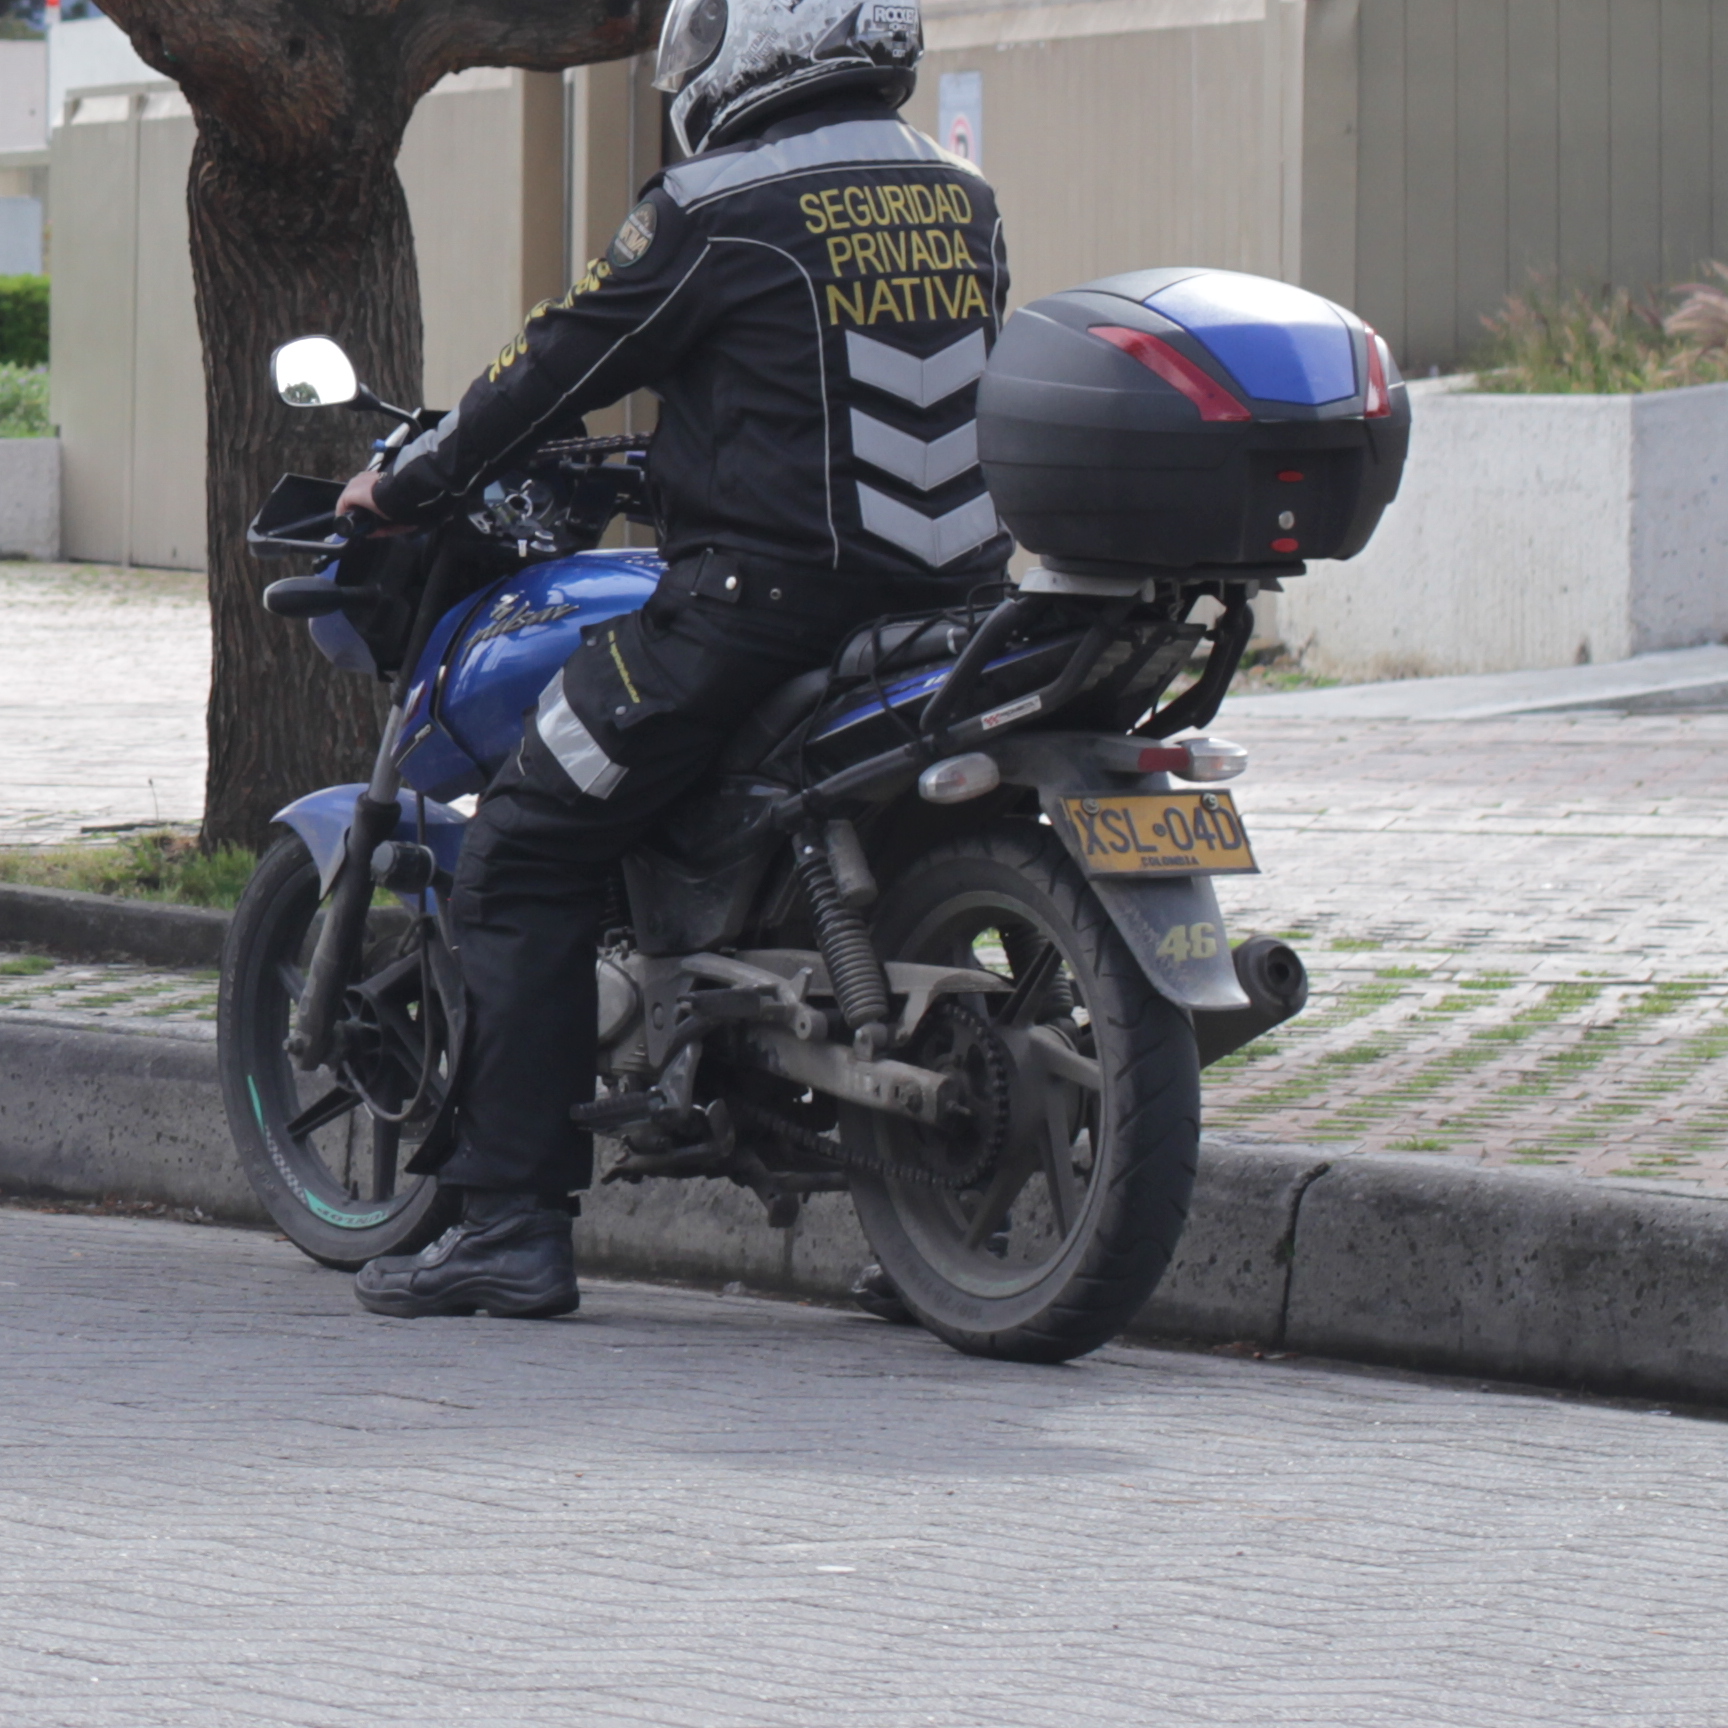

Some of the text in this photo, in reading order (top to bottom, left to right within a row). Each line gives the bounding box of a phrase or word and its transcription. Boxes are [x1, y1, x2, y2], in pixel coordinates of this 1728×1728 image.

[799, 183, 973, 234] SEGURIDAD
[826, 229, 978, 278] PRIVADA
[825, 274, 990, 326] NATIVA
[1141, 855, 1200, 867] COLOMBIA
[1155, 923, 1217, 963] 46
